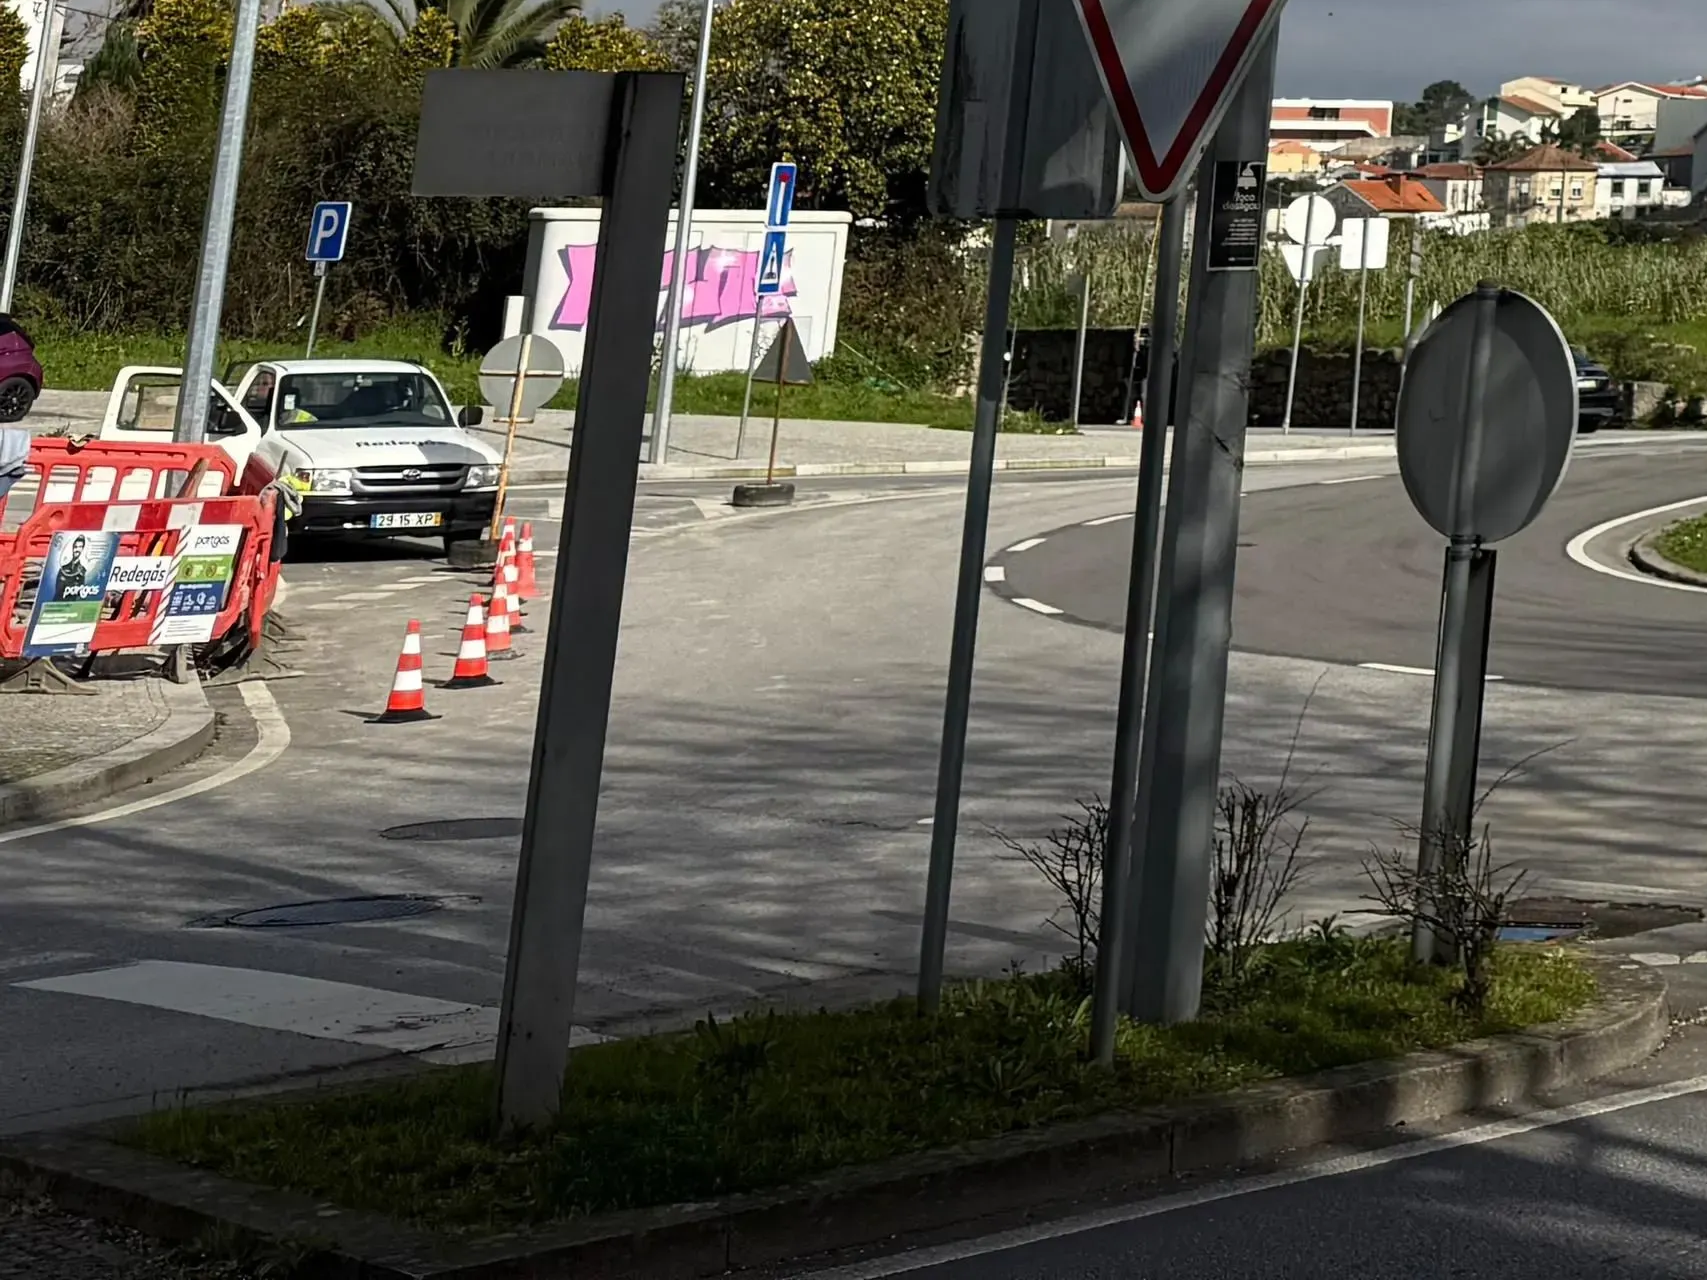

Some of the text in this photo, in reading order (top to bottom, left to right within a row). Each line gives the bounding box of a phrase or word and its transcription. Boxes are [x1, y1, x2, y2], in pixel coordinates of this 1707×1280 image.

[314, 209, 339, 254] P
[110, 561, 166, 588] Redegás
[63, 584, 100, 598] portgas
